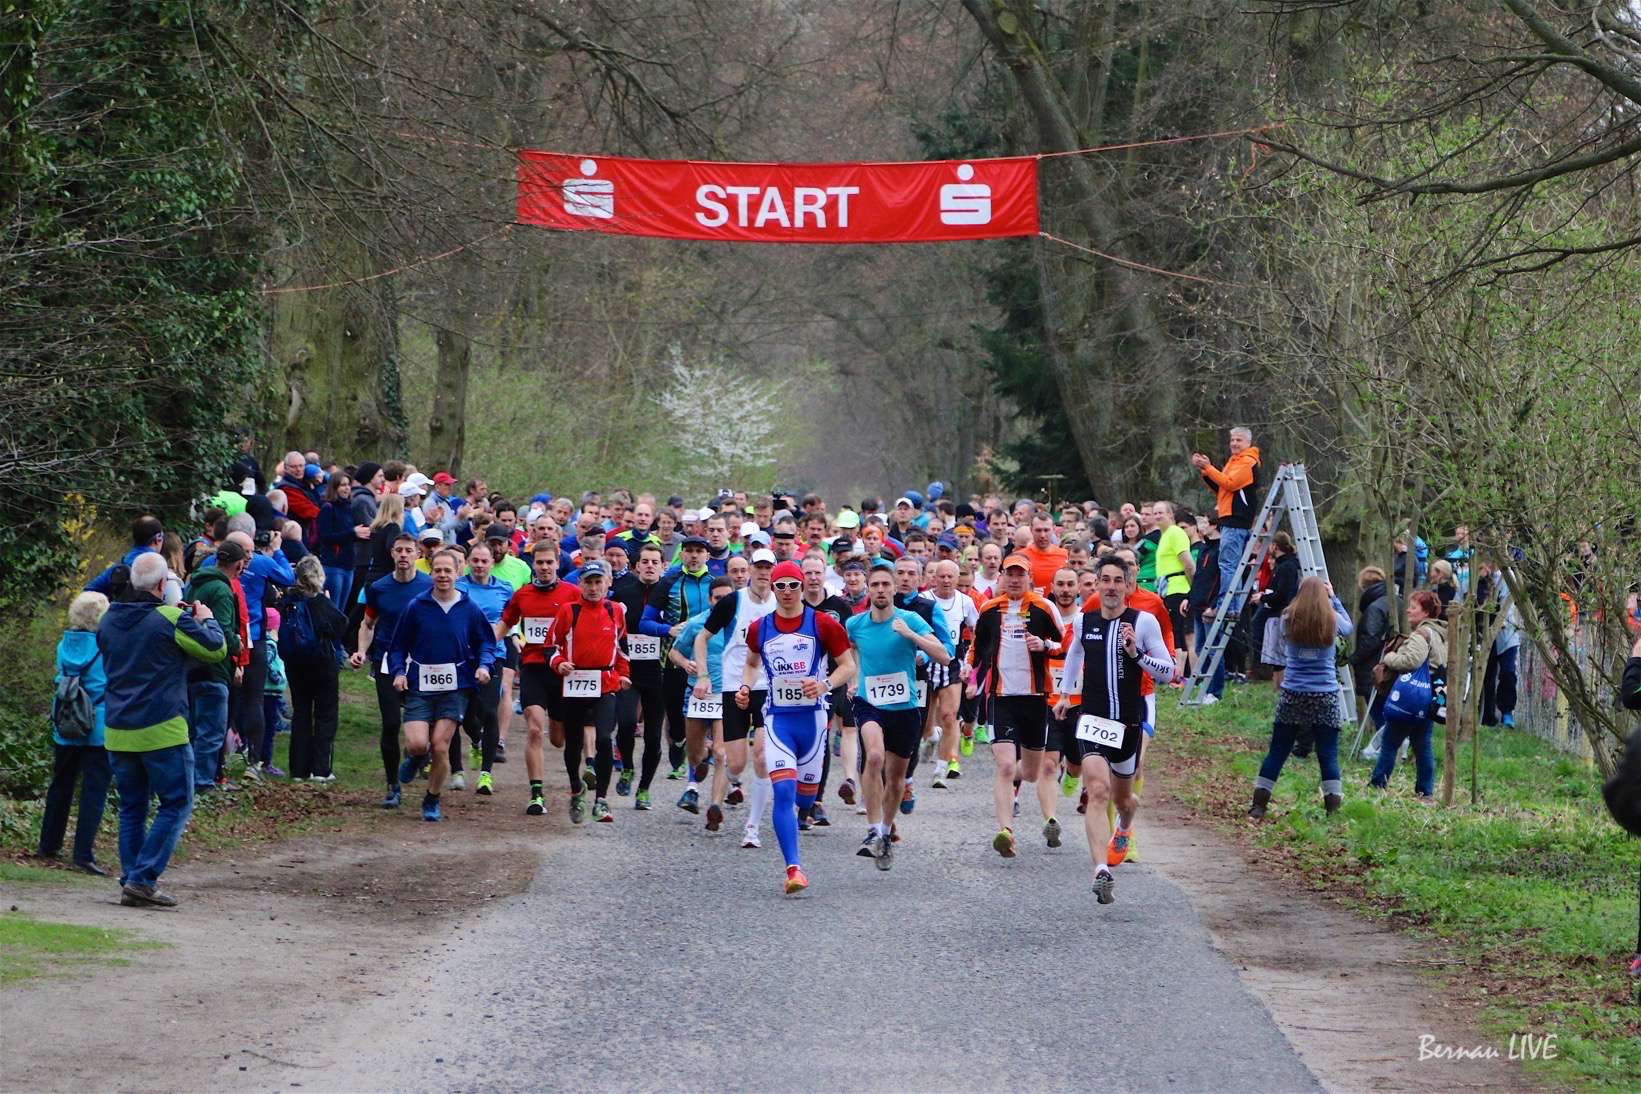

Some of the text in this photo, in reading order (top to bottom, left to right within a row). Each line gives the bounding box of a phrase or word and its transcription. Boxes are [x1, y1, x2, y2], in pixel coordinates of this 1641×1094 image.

[695, 184, 860, 228] START
[628, 643, 656, 654] 1855
[423, 673, 453, 685] 1866
[567, 679, 597, 691] 1775
[777, 688, 808, 700] 185
[870, 683, 905, 699] 1739
[692, 702, 723, 713] 1857
[1082, 724, 1119, 743] 1702
